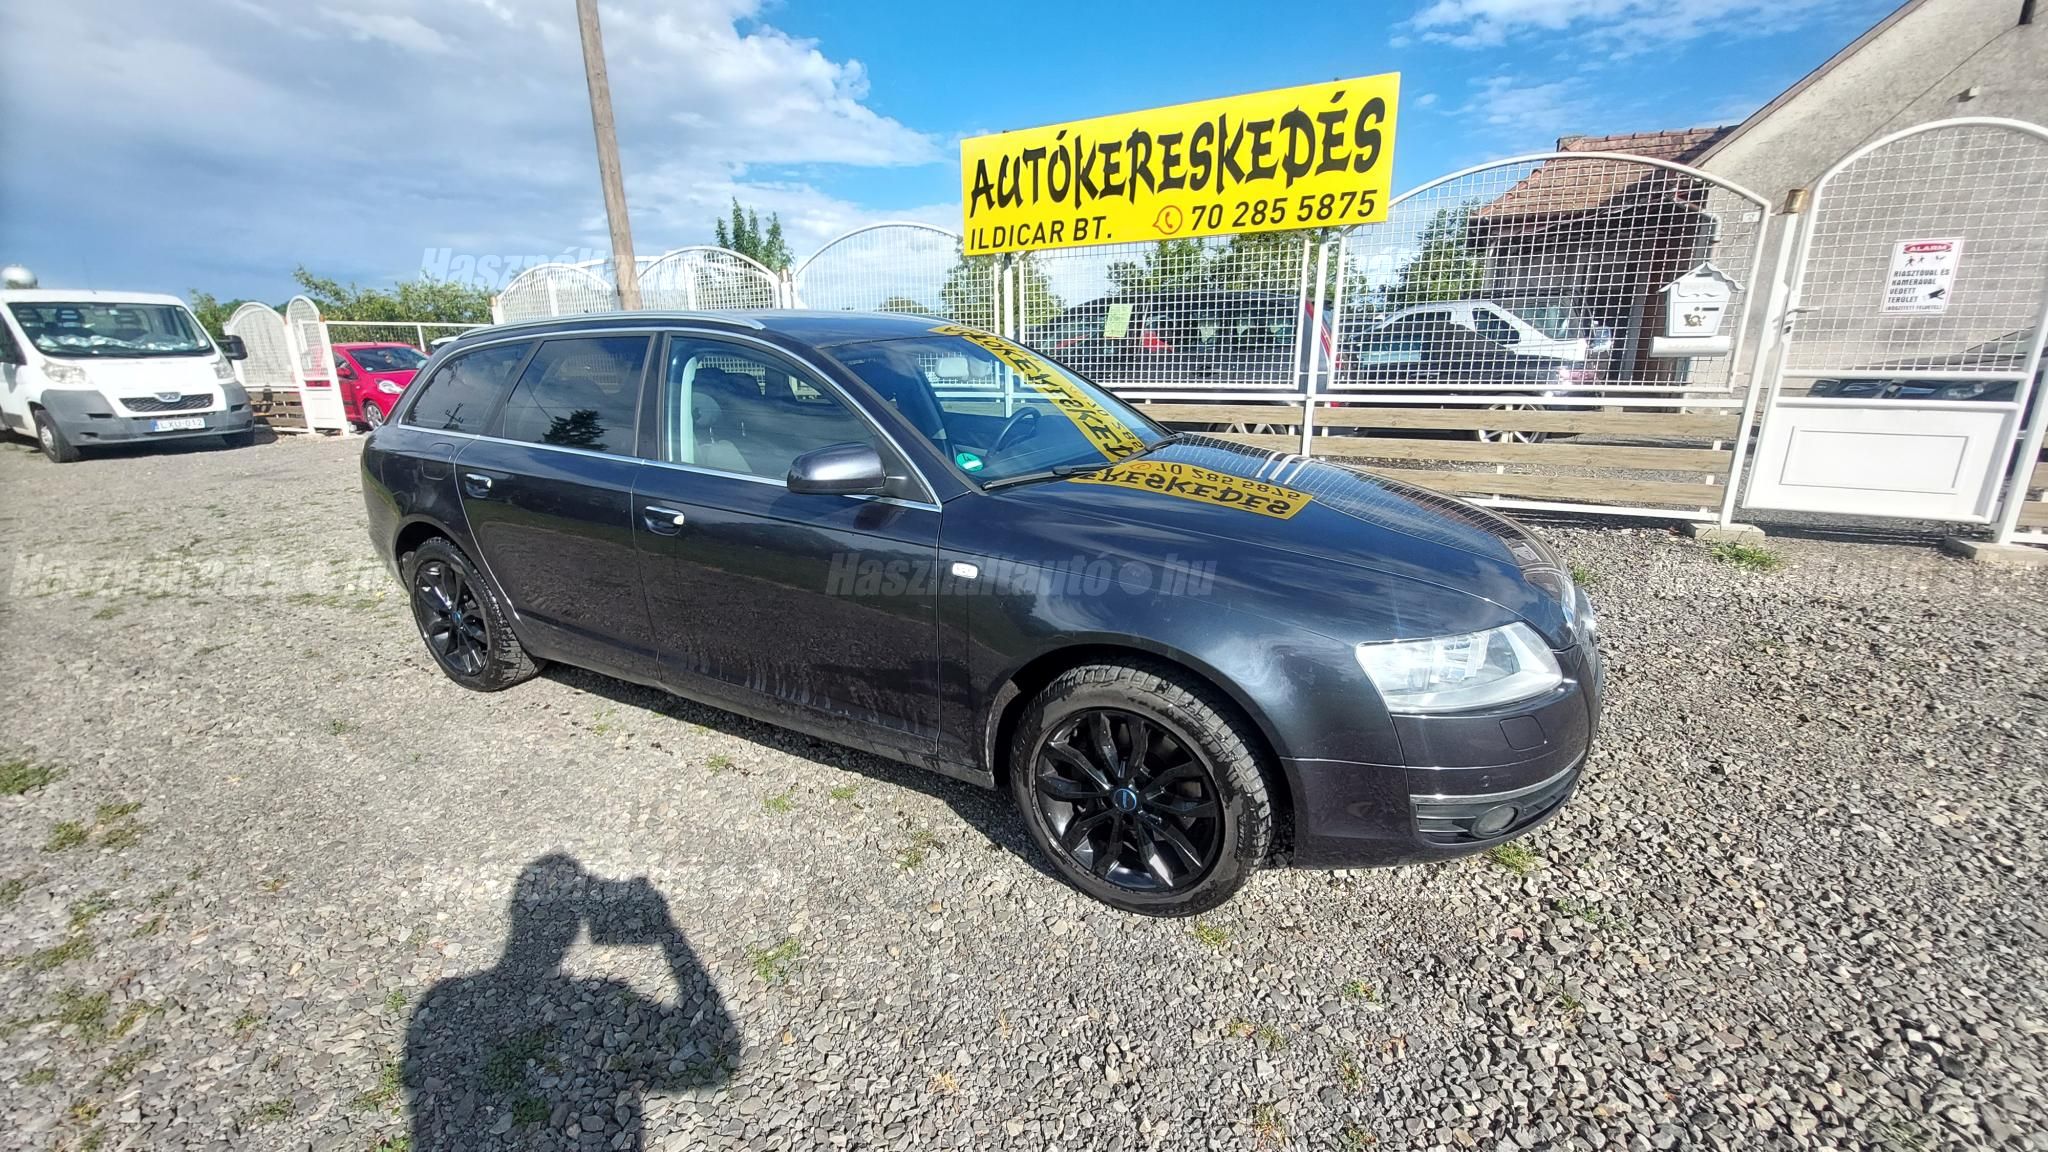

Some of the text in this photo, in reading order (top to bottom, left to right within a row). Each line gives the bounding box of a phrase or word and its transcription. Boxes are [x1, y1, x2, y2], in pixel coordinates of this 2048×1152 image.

[970, 90, 1386, 218] AUTÓKERESKEDÉS
[1190, 190, 1377, 231] 70 285 5875
[970, 216, 1112, 250] ILDICAR BT.
